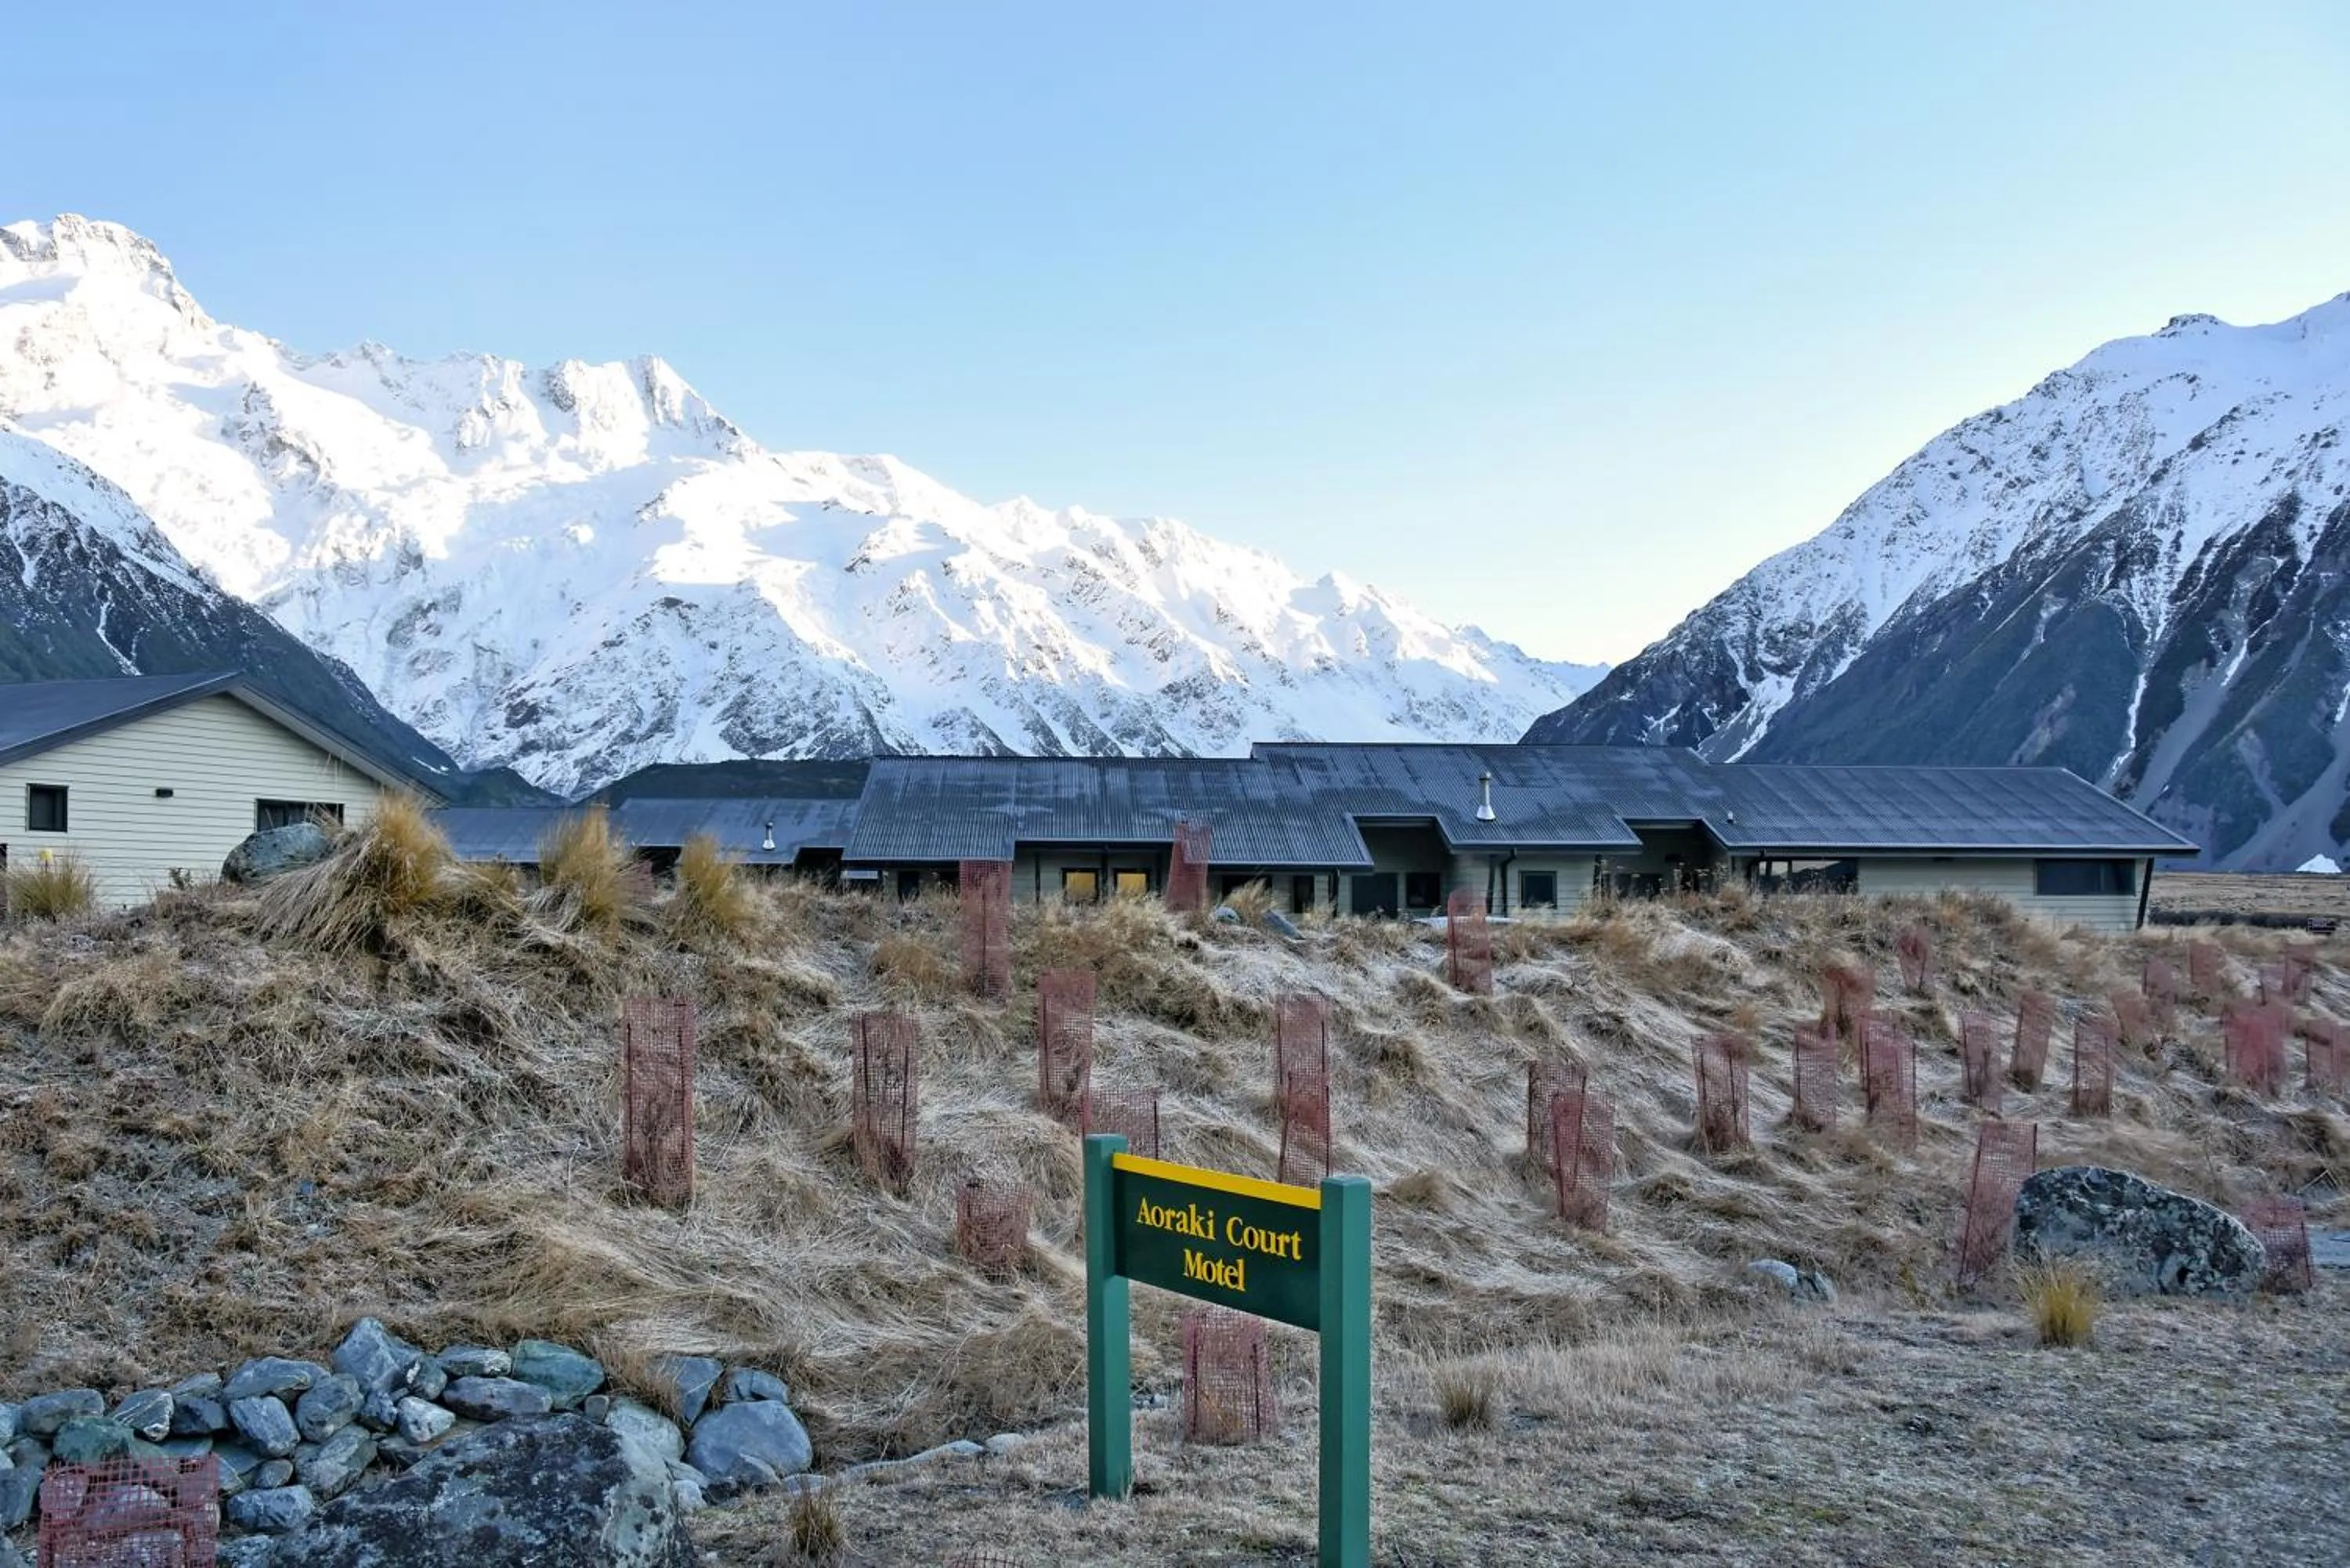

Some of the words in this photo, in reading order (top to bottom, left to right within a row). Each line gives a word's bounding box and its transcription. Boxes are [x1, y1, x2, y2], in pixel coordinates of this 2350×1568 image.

[1137, 1197, 1216, 1241] Aoraki
[1225, 1216, 1302, 1261] Court
[1184, 1248, 1246, 1292] Motel
